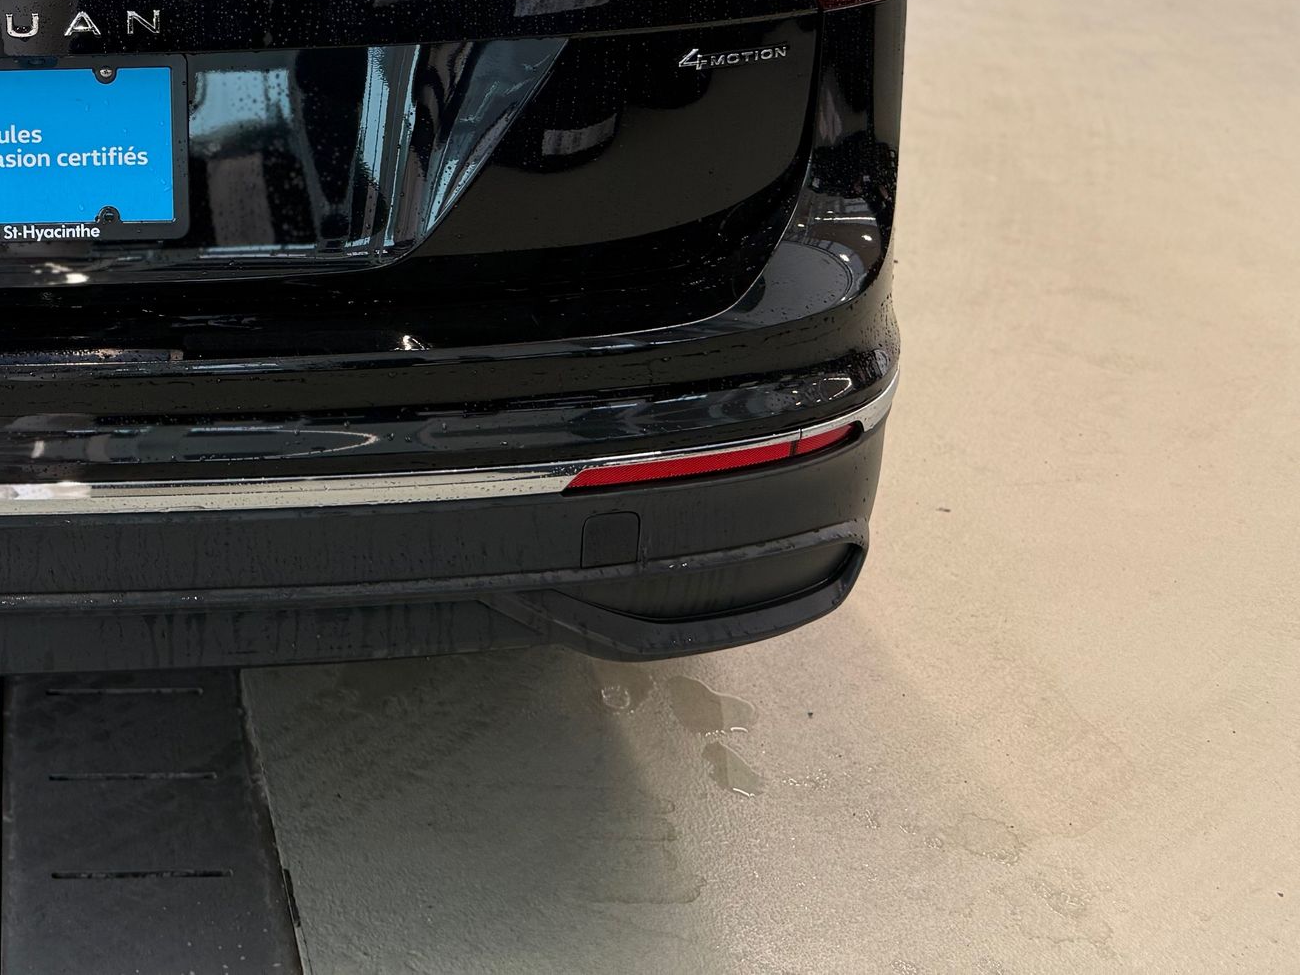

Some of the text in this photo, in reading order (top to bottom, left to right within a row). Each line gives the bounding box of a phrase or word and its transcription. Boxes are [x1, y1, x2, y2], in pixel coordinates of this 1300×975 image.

[679, 47, 787, 70] 4MOTION
[57, 146, 149, 167] certifiés
[4, 224, 101, 241] St-Hyacinthe
